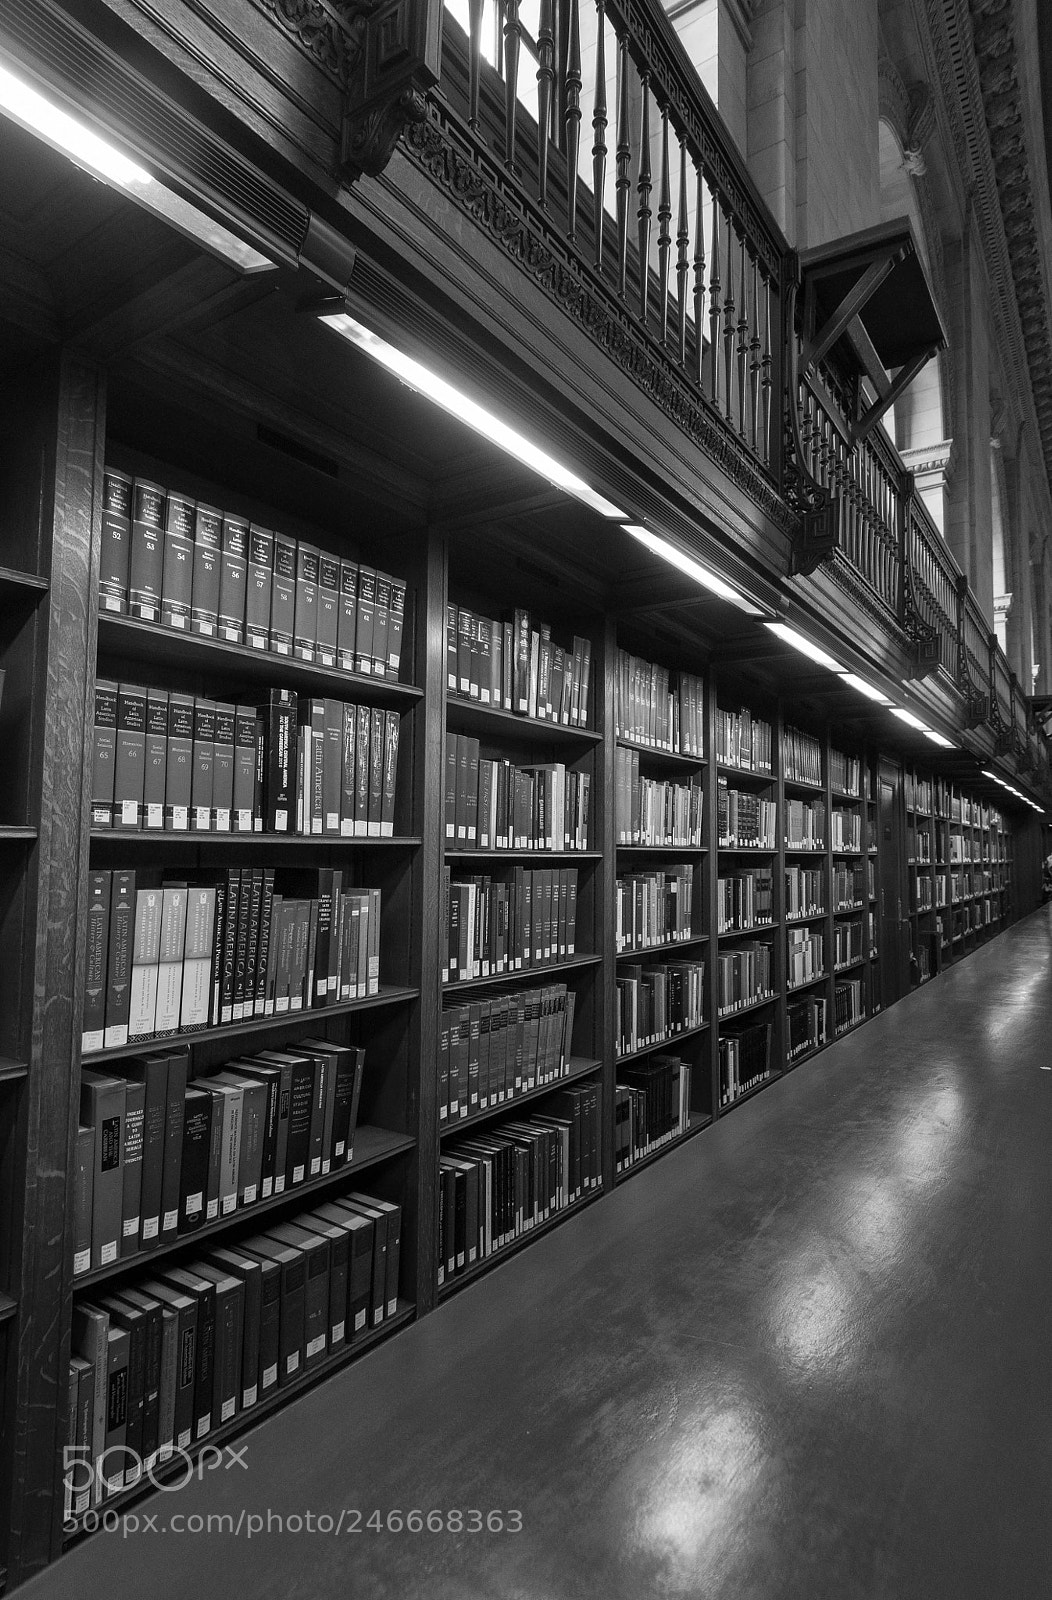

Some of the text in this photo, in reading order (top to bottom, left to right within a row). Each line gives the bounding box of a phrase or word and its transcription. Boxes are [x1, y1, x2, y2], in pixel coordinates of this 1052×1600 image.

[112, 531, 122, 540] 52
[146, 542, 154, 550] 53
[177, 552, 186, 561] 54
[204, 562, 212, 570] 55
[314, 738, 324, 810] Latin America
[225, 883, 239, 978] LATIN AMERICA
[238, 884, 251, 978] LATIN AMERICA
[248, 882, 262, 974] LATIN AMERICA
[260, 883, 273, 974] LATIN AMERICA
[124, 1138, 143, 1146] AMERICAN
